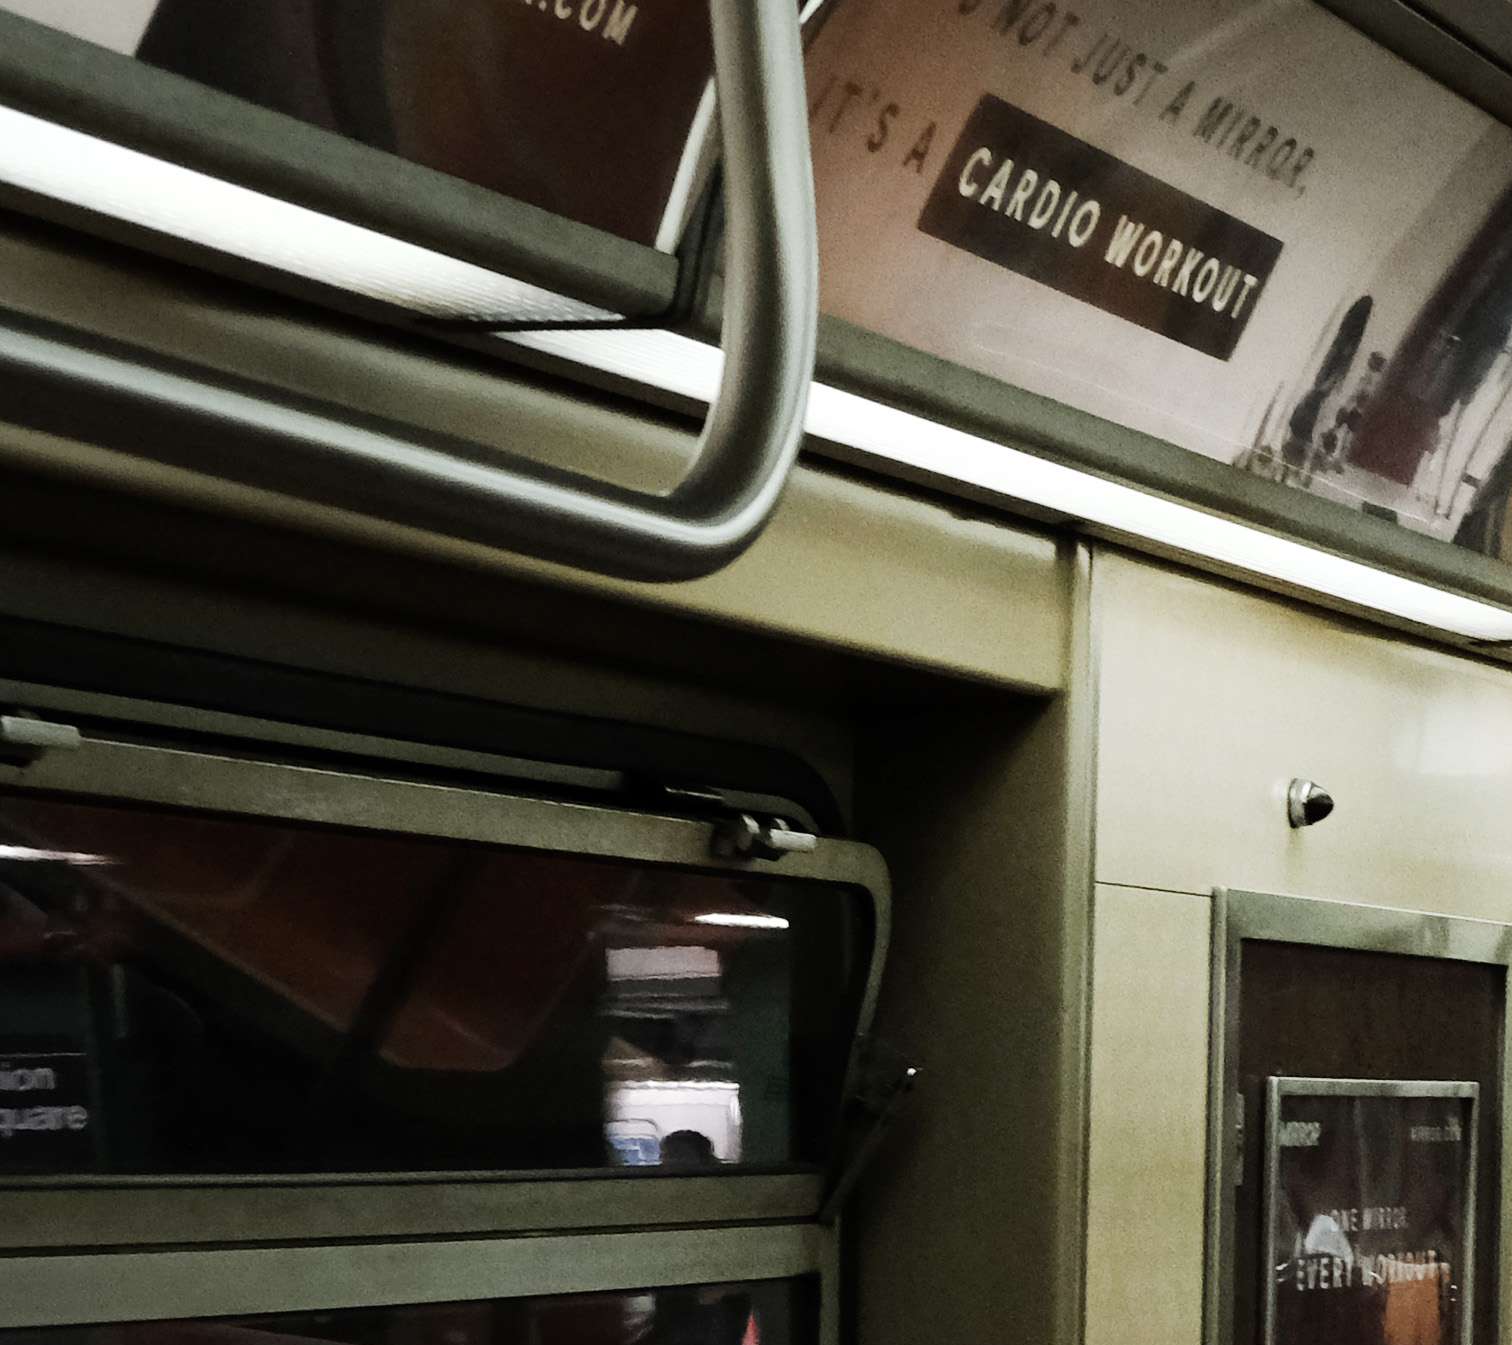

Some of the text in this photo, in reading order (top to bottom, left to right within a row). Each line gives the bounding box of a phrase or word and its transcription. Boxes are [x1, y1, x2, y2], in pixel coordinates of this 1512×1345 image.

[1070, 32, 1169, 106] JUST
[1158, 79, 1197, 124] A
[903, 121, 937, 174] A
[958, 146, 1259, 319] CARDIO WORKOUT
